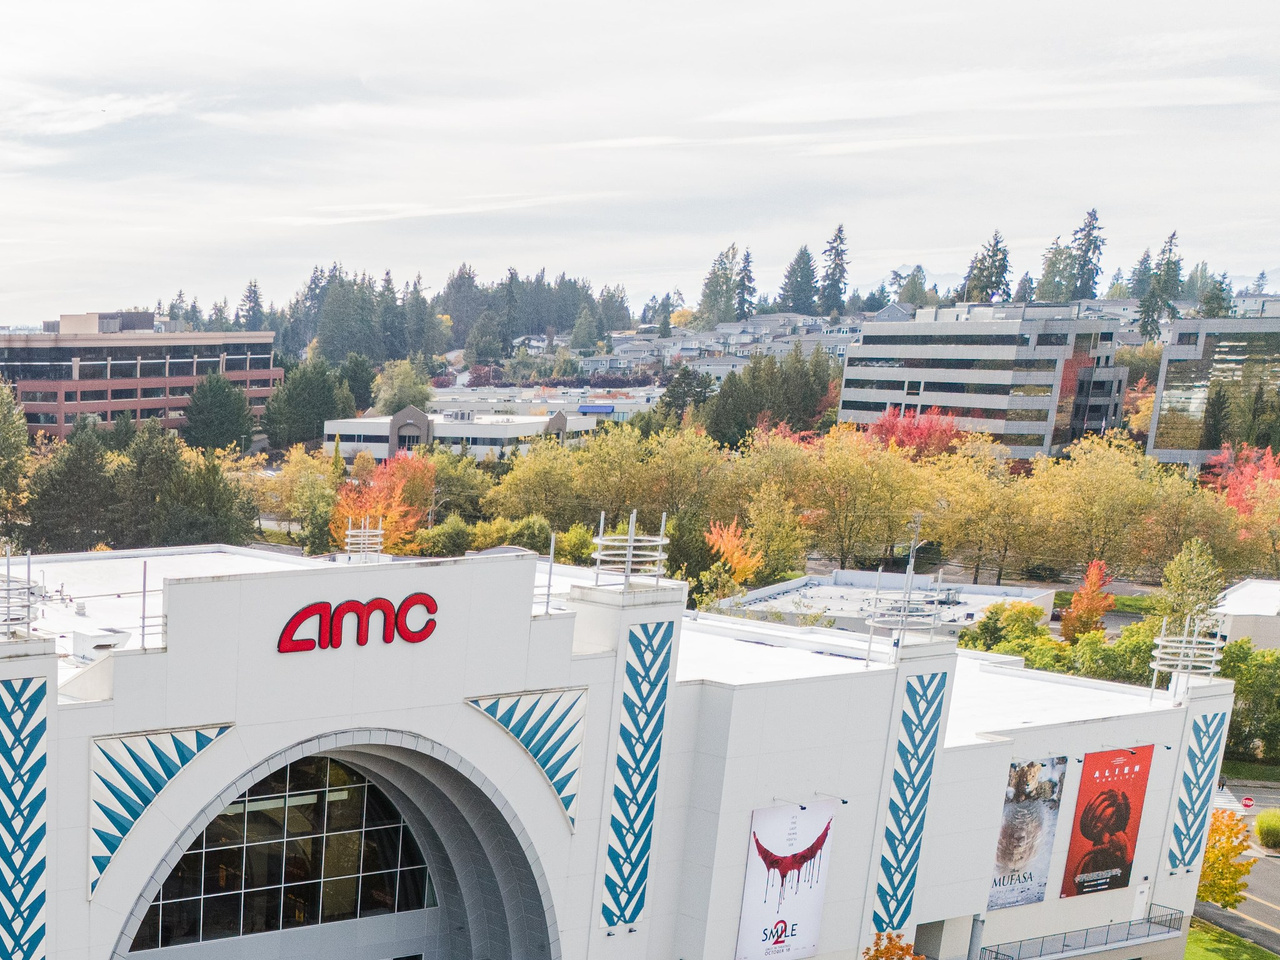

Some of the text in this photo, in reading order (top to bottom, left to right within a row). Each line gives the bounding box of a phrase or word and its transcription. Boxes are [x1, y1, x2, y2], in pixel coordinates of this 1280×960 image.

[1093, 764, 1140, 778] ALIEN
[991, 871, 1034, 889] MUFASA
[761, 923, 799, 942] SMILE
